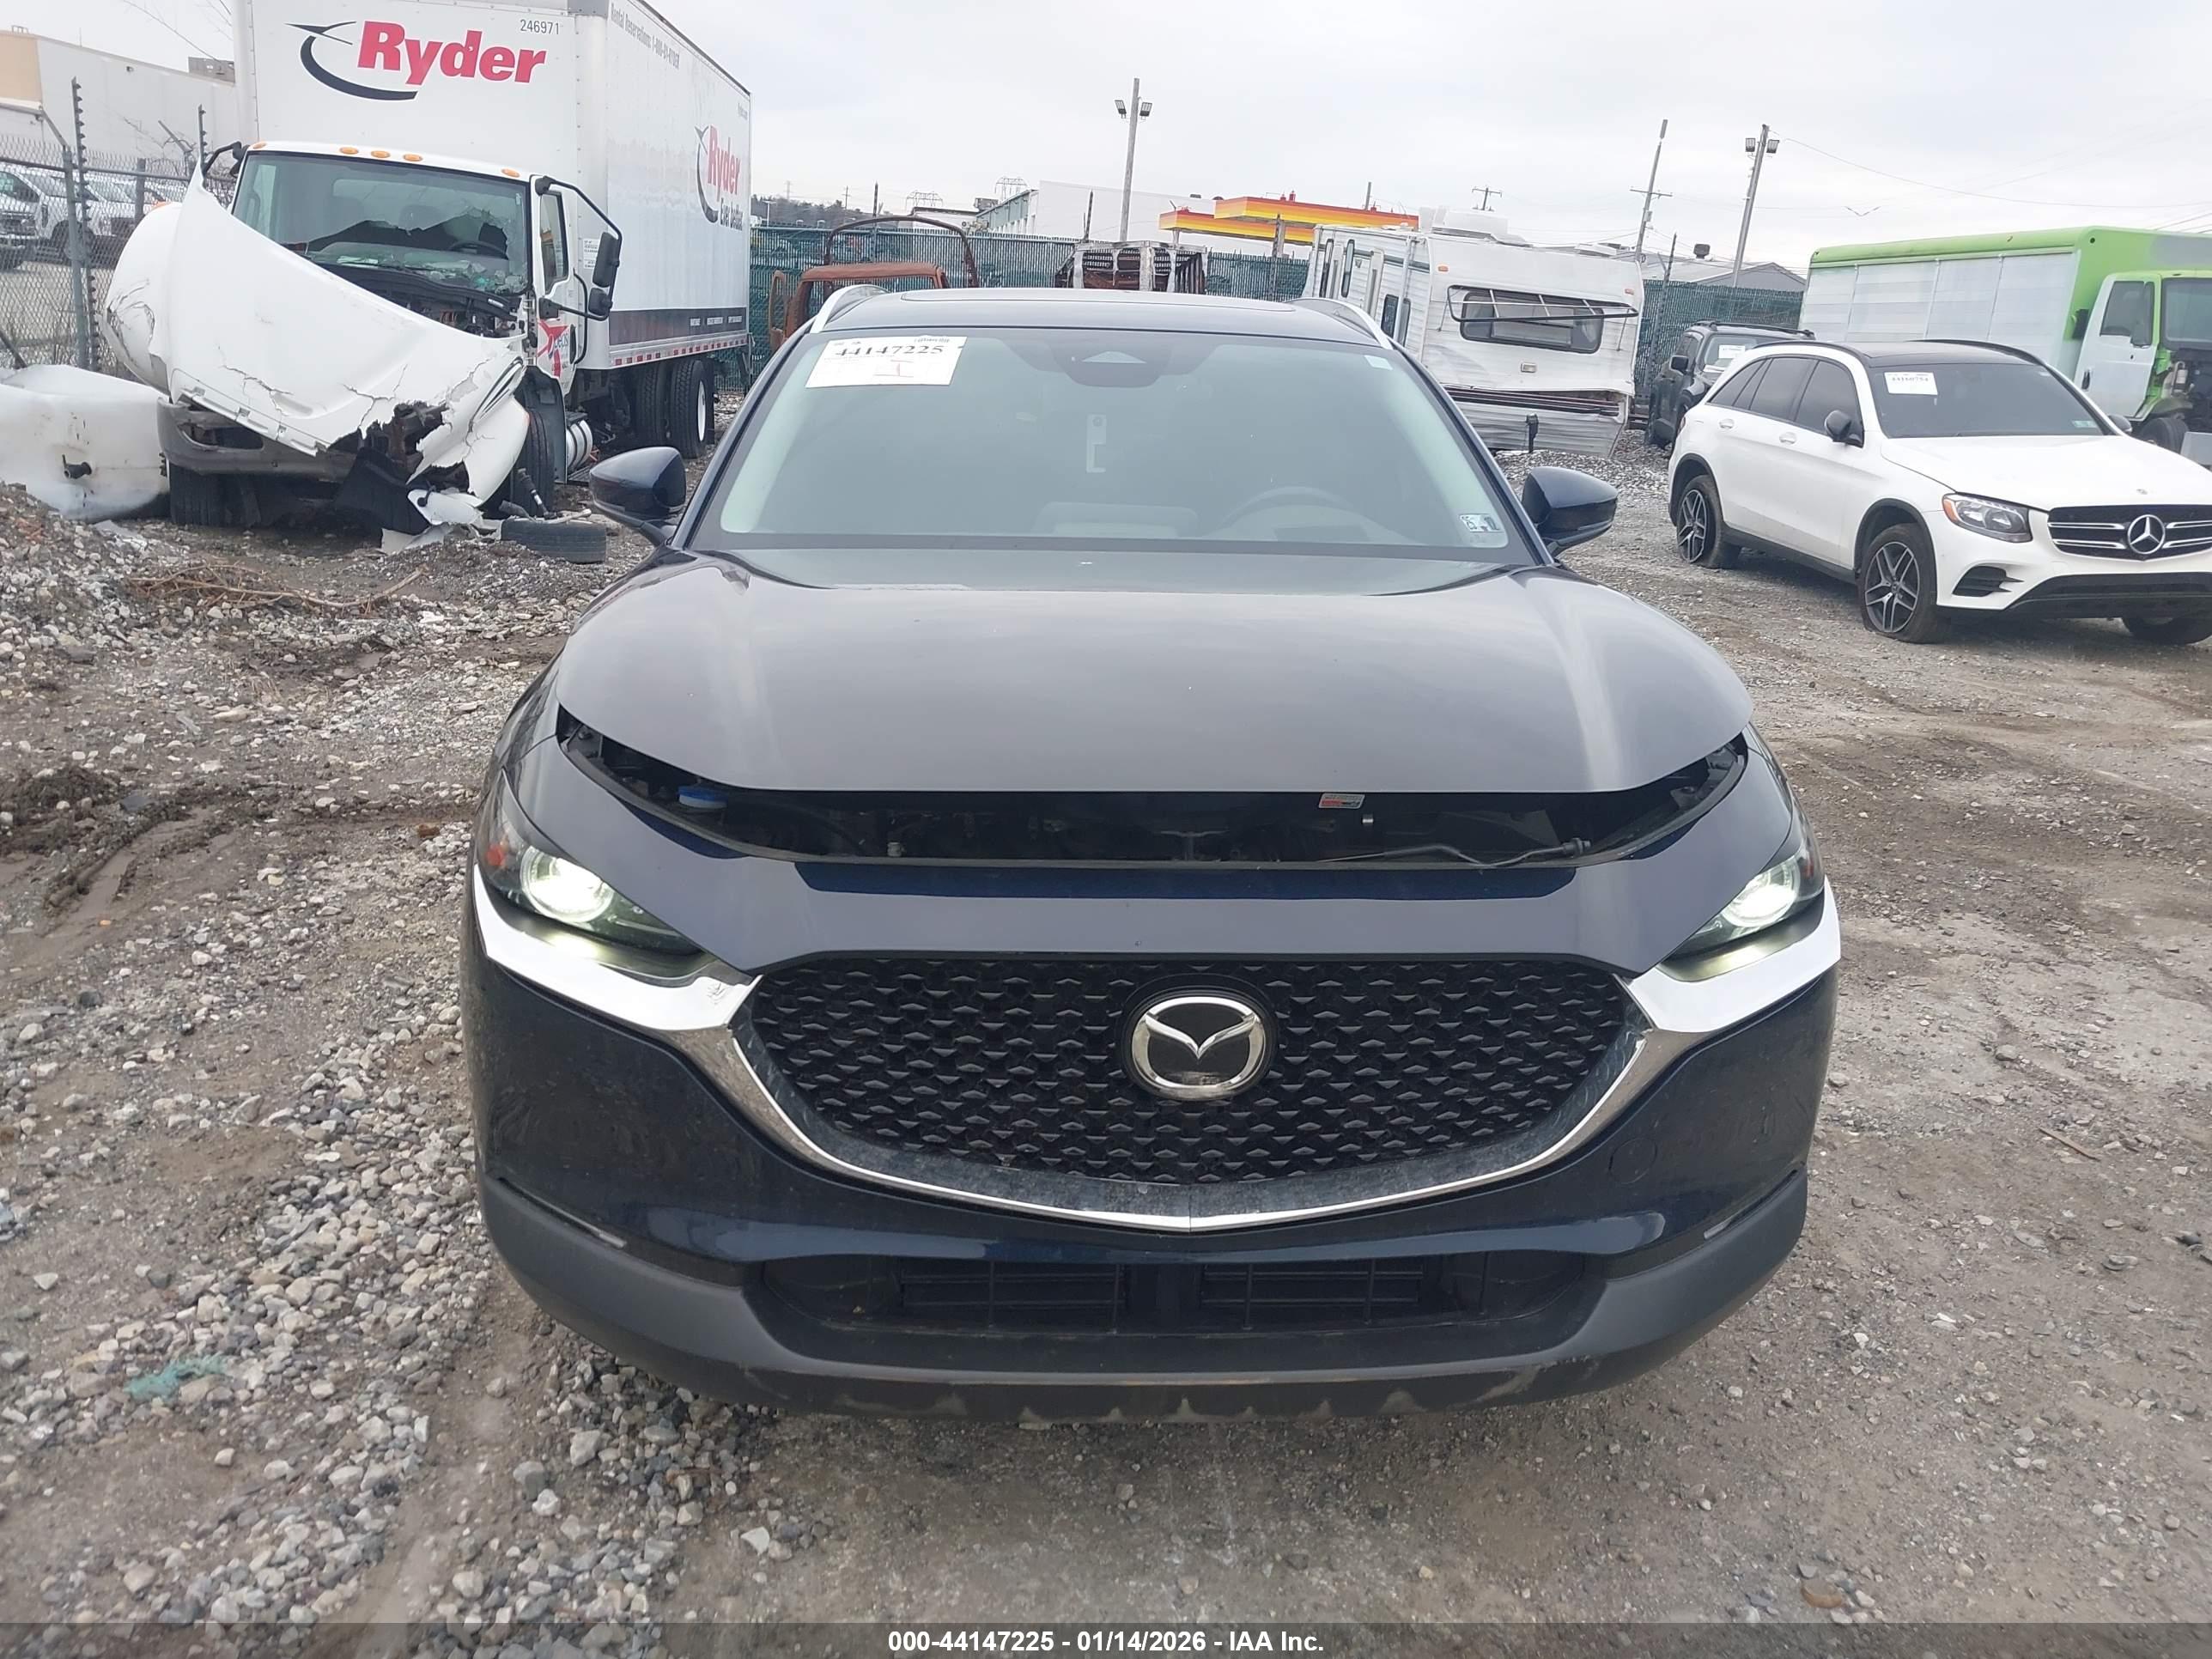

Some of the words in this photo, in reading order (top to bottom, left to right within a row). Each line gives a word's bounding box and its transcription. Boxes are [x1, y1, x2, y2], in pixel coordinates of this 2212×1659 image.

[520, 19, 559, 34] 246971
[357, 21, 546, 85] Ryder
[708, 125, 740, 202] Ryder
[835, 345, 944, 356] 44147225
